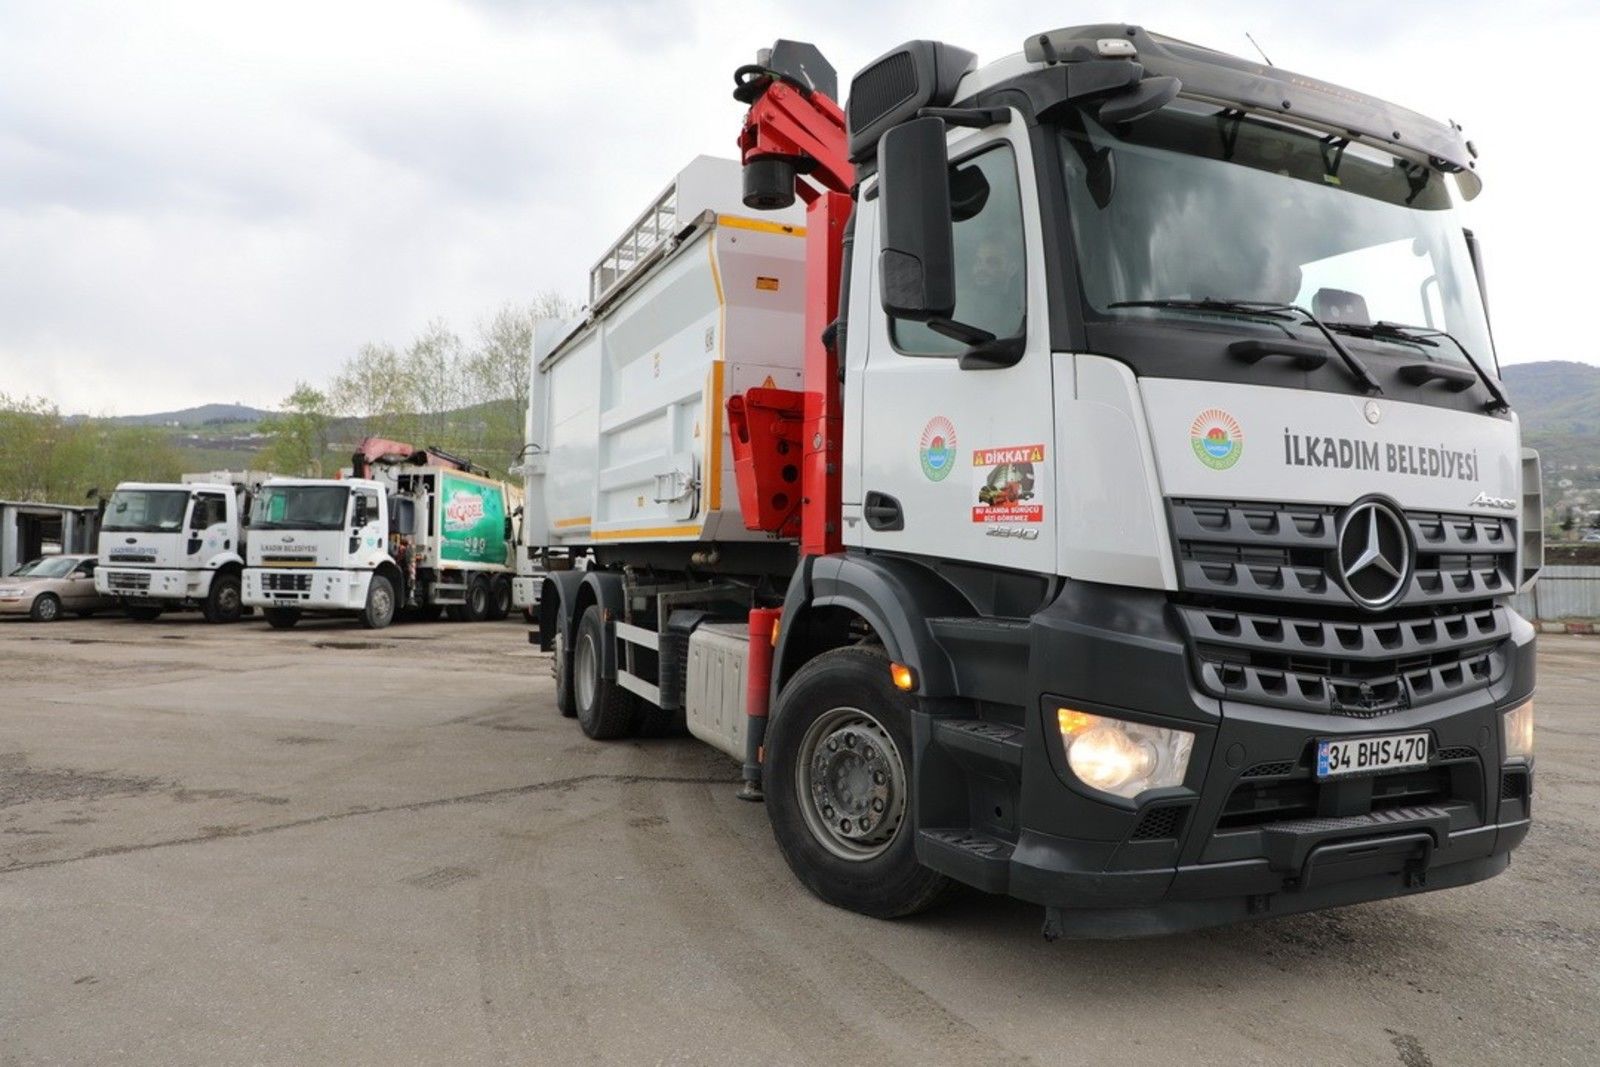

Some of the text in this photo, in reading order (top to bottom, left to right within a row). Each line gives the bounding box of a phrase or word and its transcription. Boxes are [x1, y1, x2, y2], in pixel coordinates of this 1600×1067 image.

[985, 450, 1031, 464] DİKKAT
[1284, 427, 1380, 472] İLKADIM
[1386, 443, 1480, 483] BELEDİYESİ
[1329, 737, 1426, 769] 34 BHS 470
